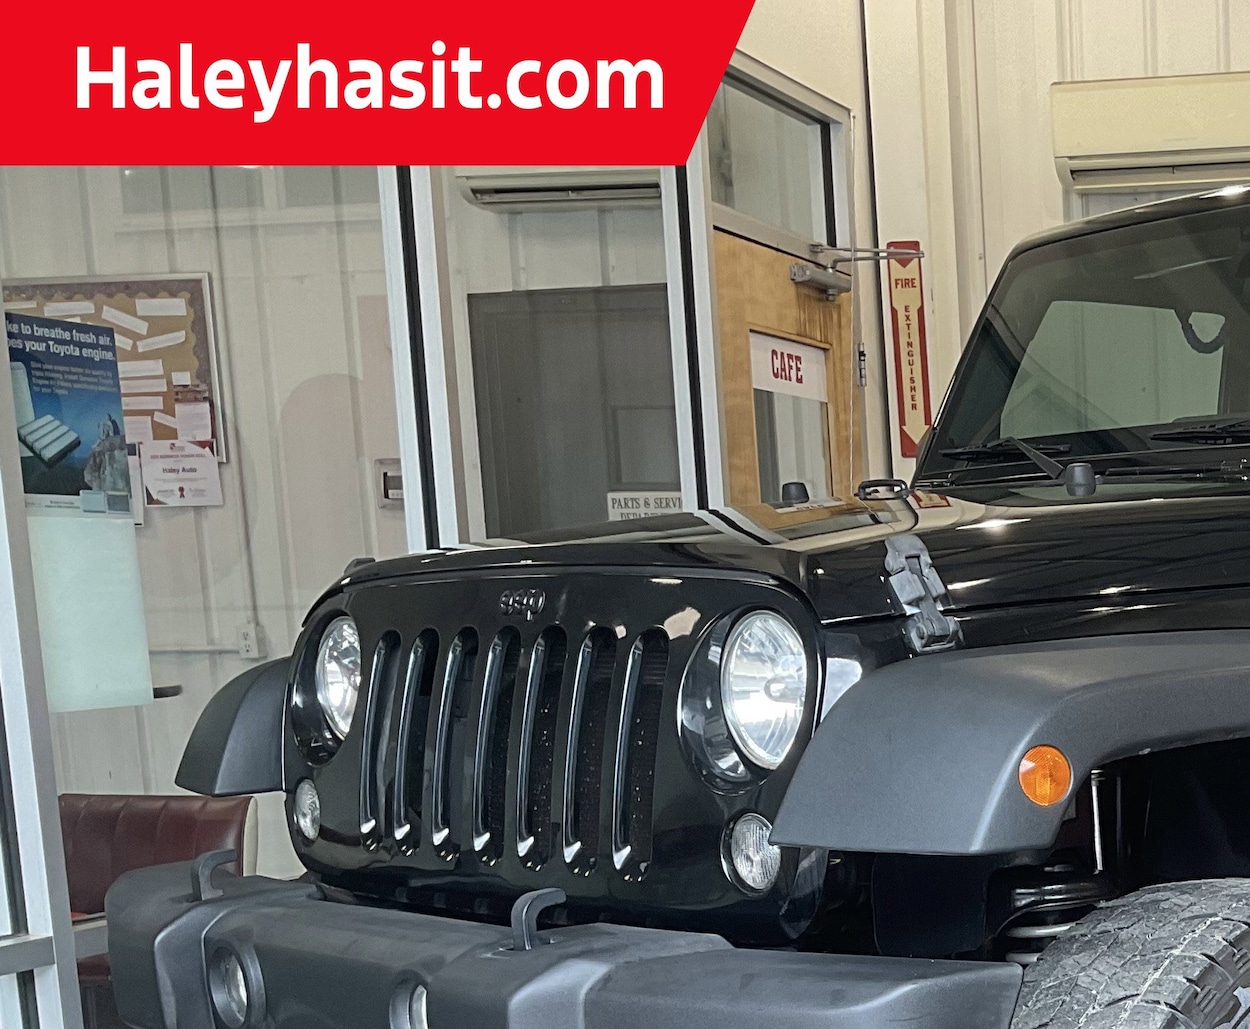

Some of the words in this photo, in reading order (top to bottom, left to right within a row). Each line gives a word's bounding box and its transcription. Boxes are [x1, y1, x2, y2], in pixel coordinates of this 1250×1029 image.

[894, 278, 917, 289] FIRE
[21, 323, 31, 335] to
[33, 324, 71, 340] breathe
[72, 329, 97, 344] fresh
[98, 334, 112, 346] air.
[24, 339, 46, 352] your
[48, 341, 80, 357] Toyota
[82, 347, 116, 361] engine.
[904, 305, 918, 411] EXTINGUISHER
[771, 349, 803, 384] CAFE
[611, 497, 640, 510] PARTS
[643, 497, 651, 509] &
